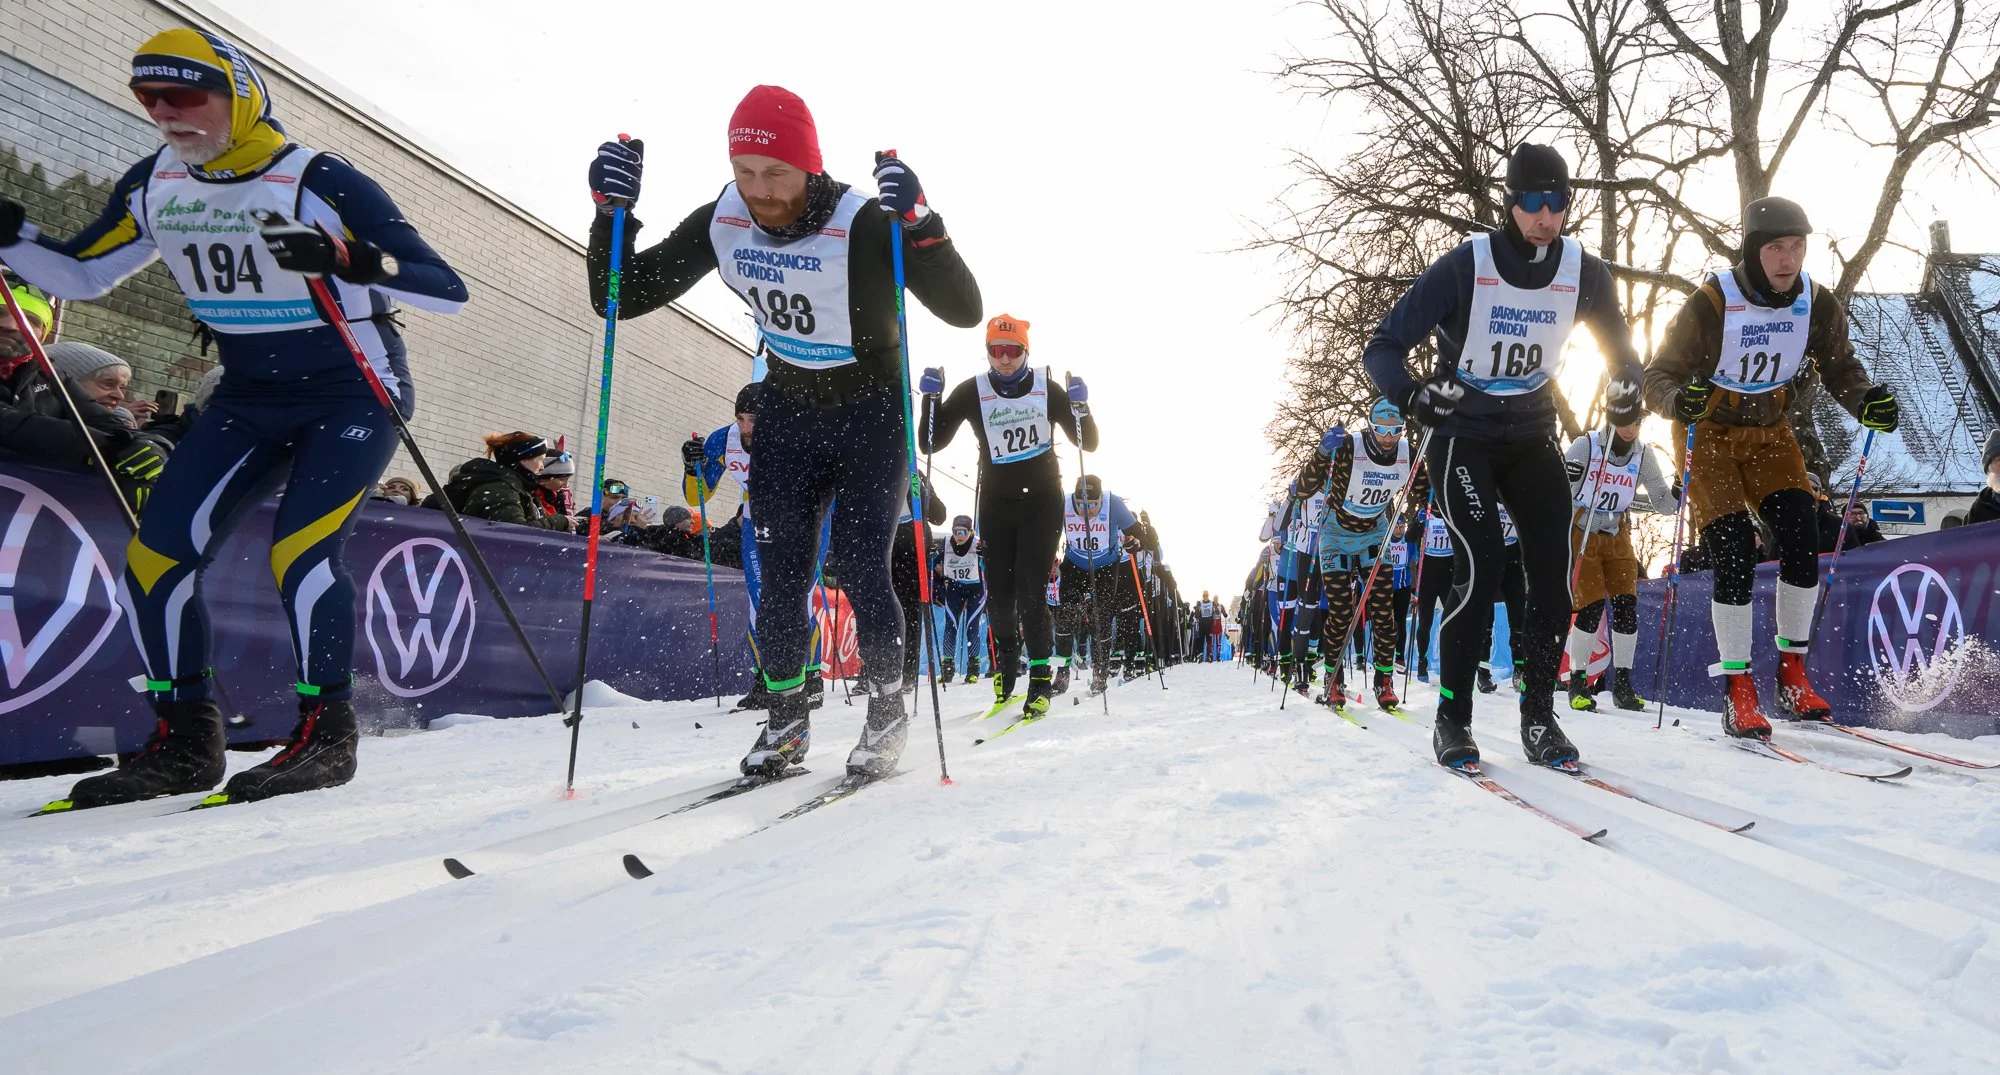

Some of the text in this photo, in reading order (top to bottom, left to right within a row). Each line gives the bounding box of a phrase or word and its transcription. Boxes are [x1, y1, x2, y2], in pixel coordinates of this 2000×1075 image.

[755, 136, 769, 145] AB
[182, 242, 264, 294] 194
[732, 248, 823, 273] BARNCANCER
[736, 260, 785, 284] FONDEN
[748, 286, 816, 335] 183
[1491, 305, 1557, 325] BARNCANCER
[1488, 320, 1528, 338] FONDEN
[1741, 321, 1794, 337] BARNCANCER
[1490, 340, 1543, 378] 169
[1738, 351, 1782, 384] 121
[994, 445, 1003, 459] 1
[1003, 424, 1040, 454] 224
[1455, 465, 1482, 510] CRAFT
[1588, 470, 1634, 489] SVEVIA
[1359, 487, 1391, 506] 203
[1597, 491, 1620, 512] 20
[1075, 537, 1099, 551] 106
[1433, 536, 1450, 549] 111
[952, 567, 971, 580] 192
